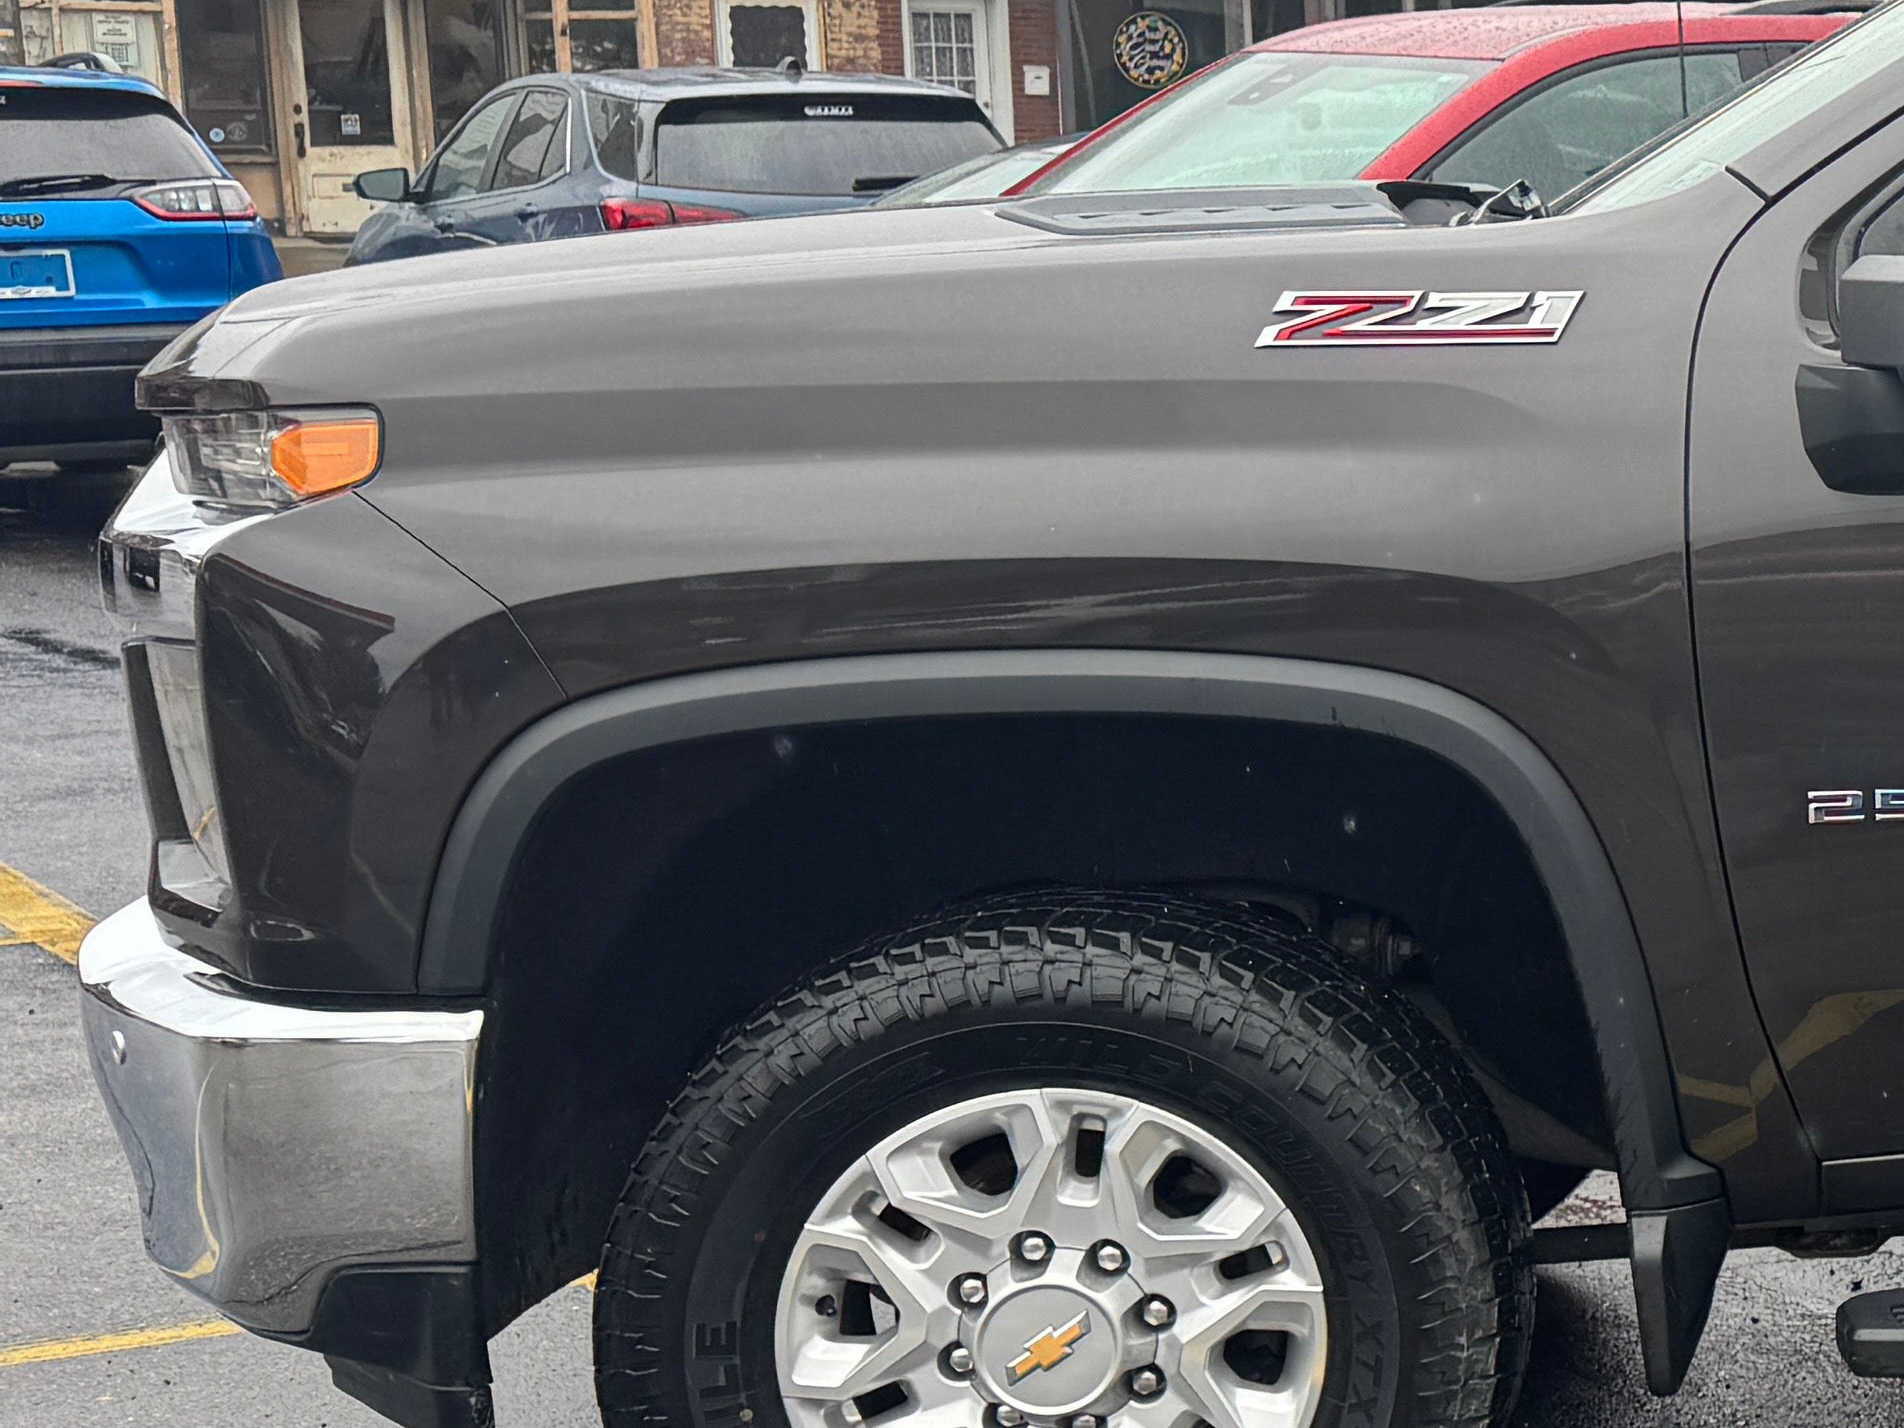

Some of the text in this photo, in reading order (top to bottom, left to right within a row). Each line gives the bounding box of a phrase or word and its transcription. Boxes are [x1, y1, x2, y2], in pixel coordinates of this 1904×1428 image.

[0, 213, 44, 228] eep
[1253, 289, 1585, 348] Z71
[1347, 1311, 1386, 1427] XTX
